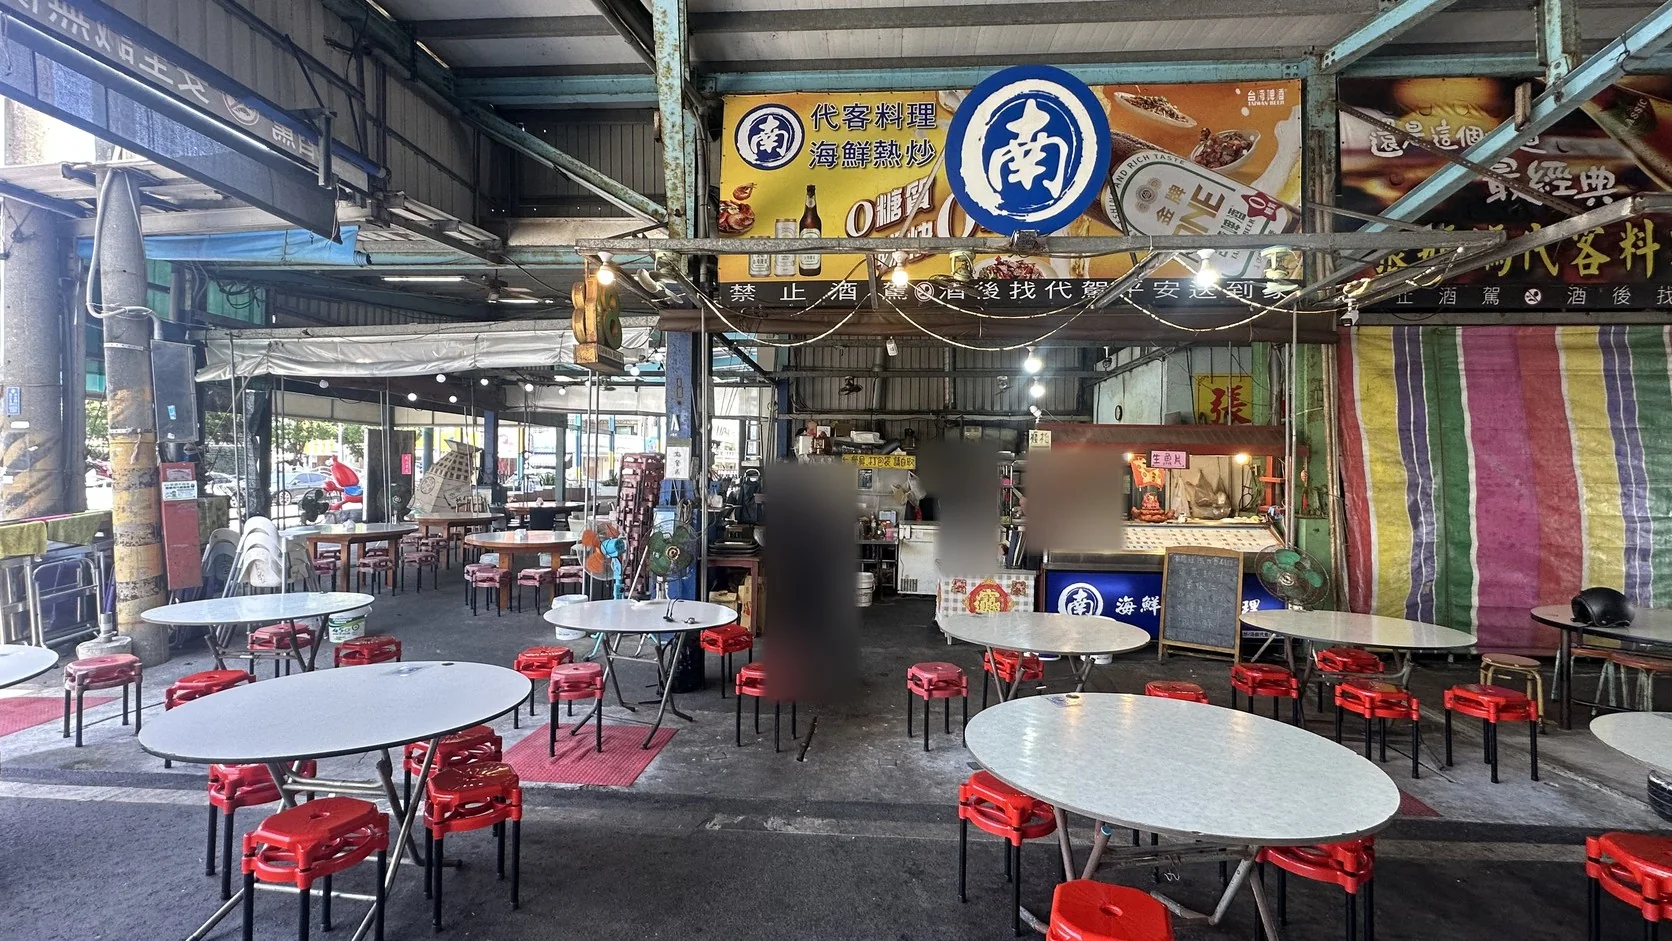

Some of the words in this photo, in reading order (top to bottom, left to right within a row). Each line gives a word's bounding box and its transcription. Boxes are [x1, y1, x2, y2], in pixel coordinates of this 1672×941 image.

[810, 102, 937, 131] 代客料理
[807, 139, 936, 169] 海鮮熱炒
[1369, 117, 1547, 157] 還是這個
[1114, 169, 1128, 189] AND
[1127, 153, 1150, 169] RICH
[1153, 153, 1185, 166] TASTE
[1485, 157, 1617, 206] 最經典
[1155, 184, 1187, 226] 金牌
[1210, 385, 1252, 425] 張
[1152, 452, 1182, 466] 生魚片
